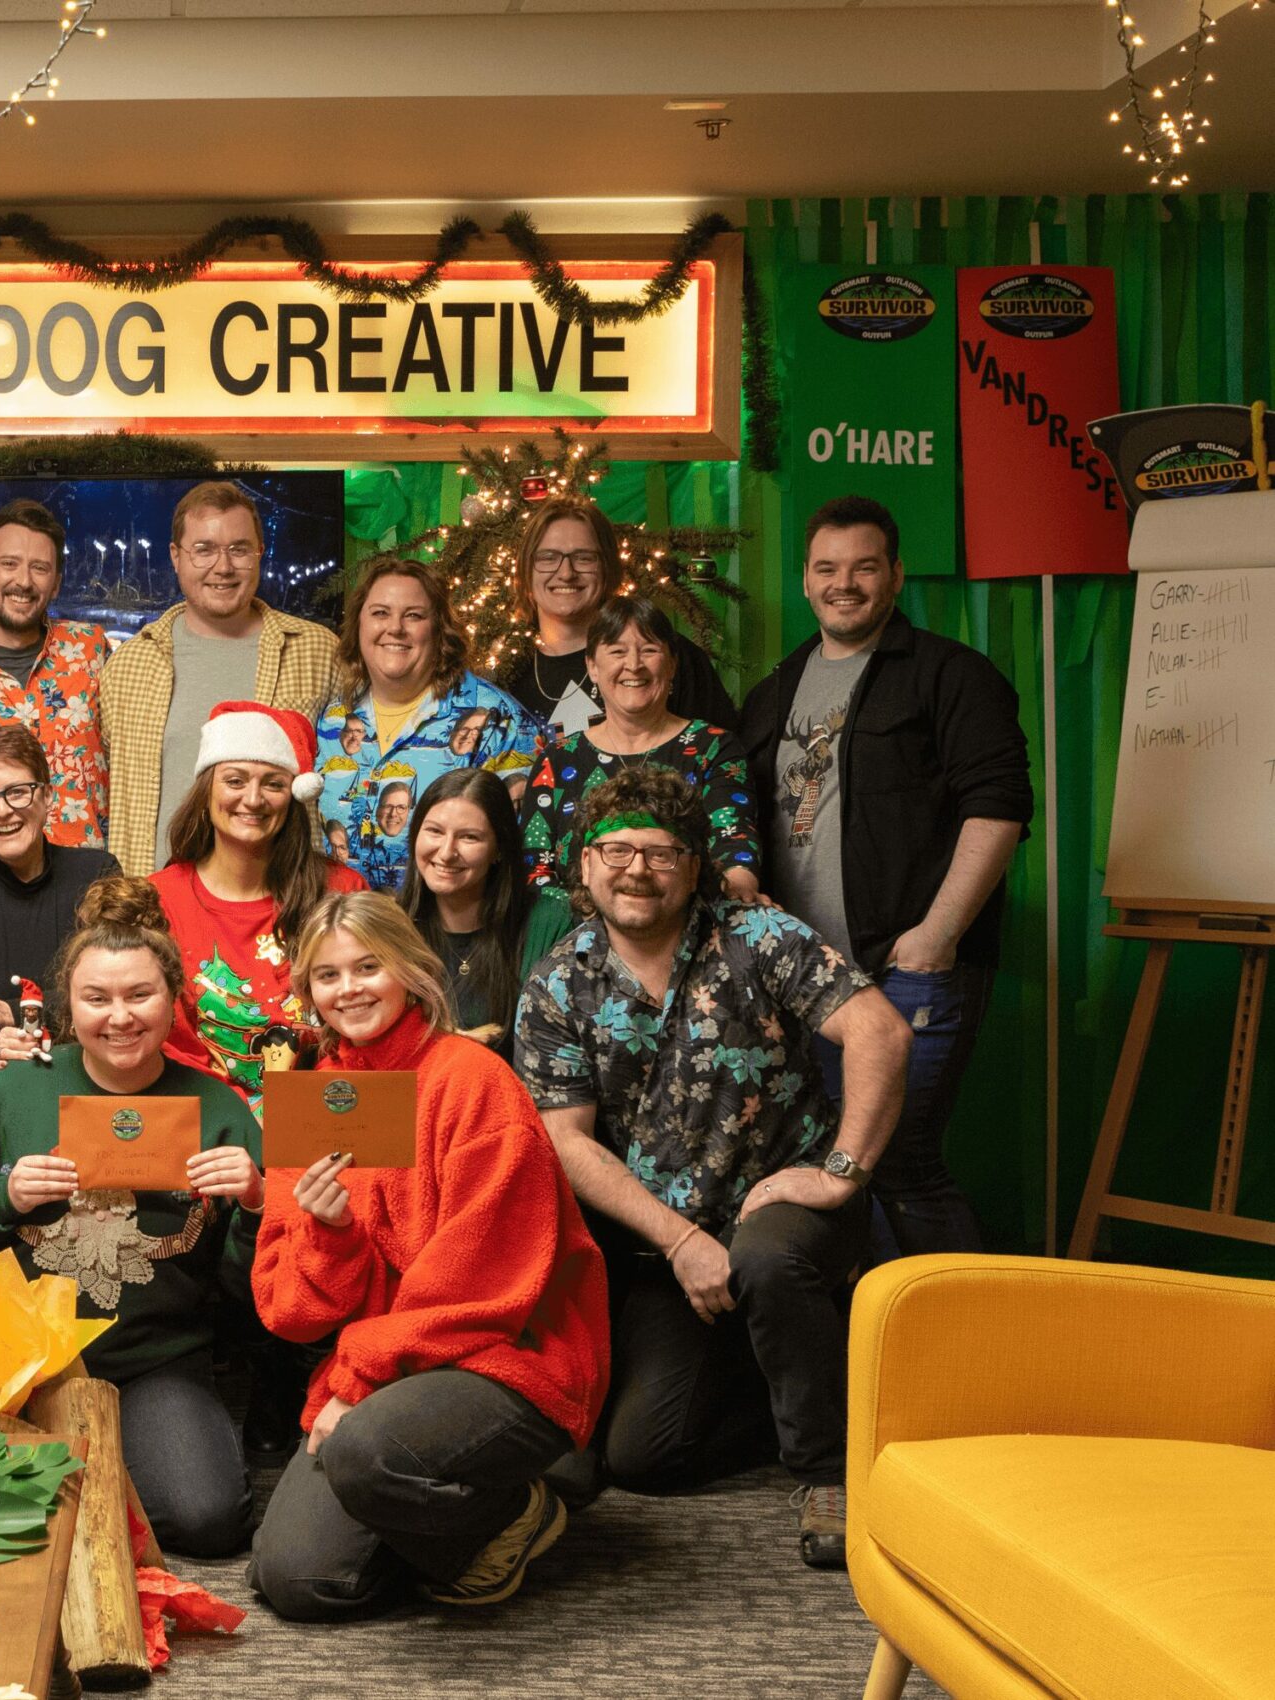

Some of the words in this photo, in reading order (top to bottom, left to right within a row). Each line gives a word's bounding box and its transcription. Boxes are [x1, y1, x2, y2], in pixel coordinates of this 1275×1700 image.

[831, 275, 870, 295] OUTSMART
[885, 275, 923, 296] OUTLAUGH
[990, 276, 1029, 297] OUTSMART
[1044, 276, 1082, 297] OUTLAUGH
[828, 300, 927, 315] SURVIVOR
[990, 300, 1085, 315] SURVIVOR
[862, 331, 892, 339] OUTFUN
[210, 300, 629, 396] CREATIVE
[808, 422, 934, 465] O'HARE
[1143, 445, 1182, 469] OUTSMART
[1196, 442, 1240, 459] OUTLAUGH
[1145, 462, 1249, 488] SURVIVOR
